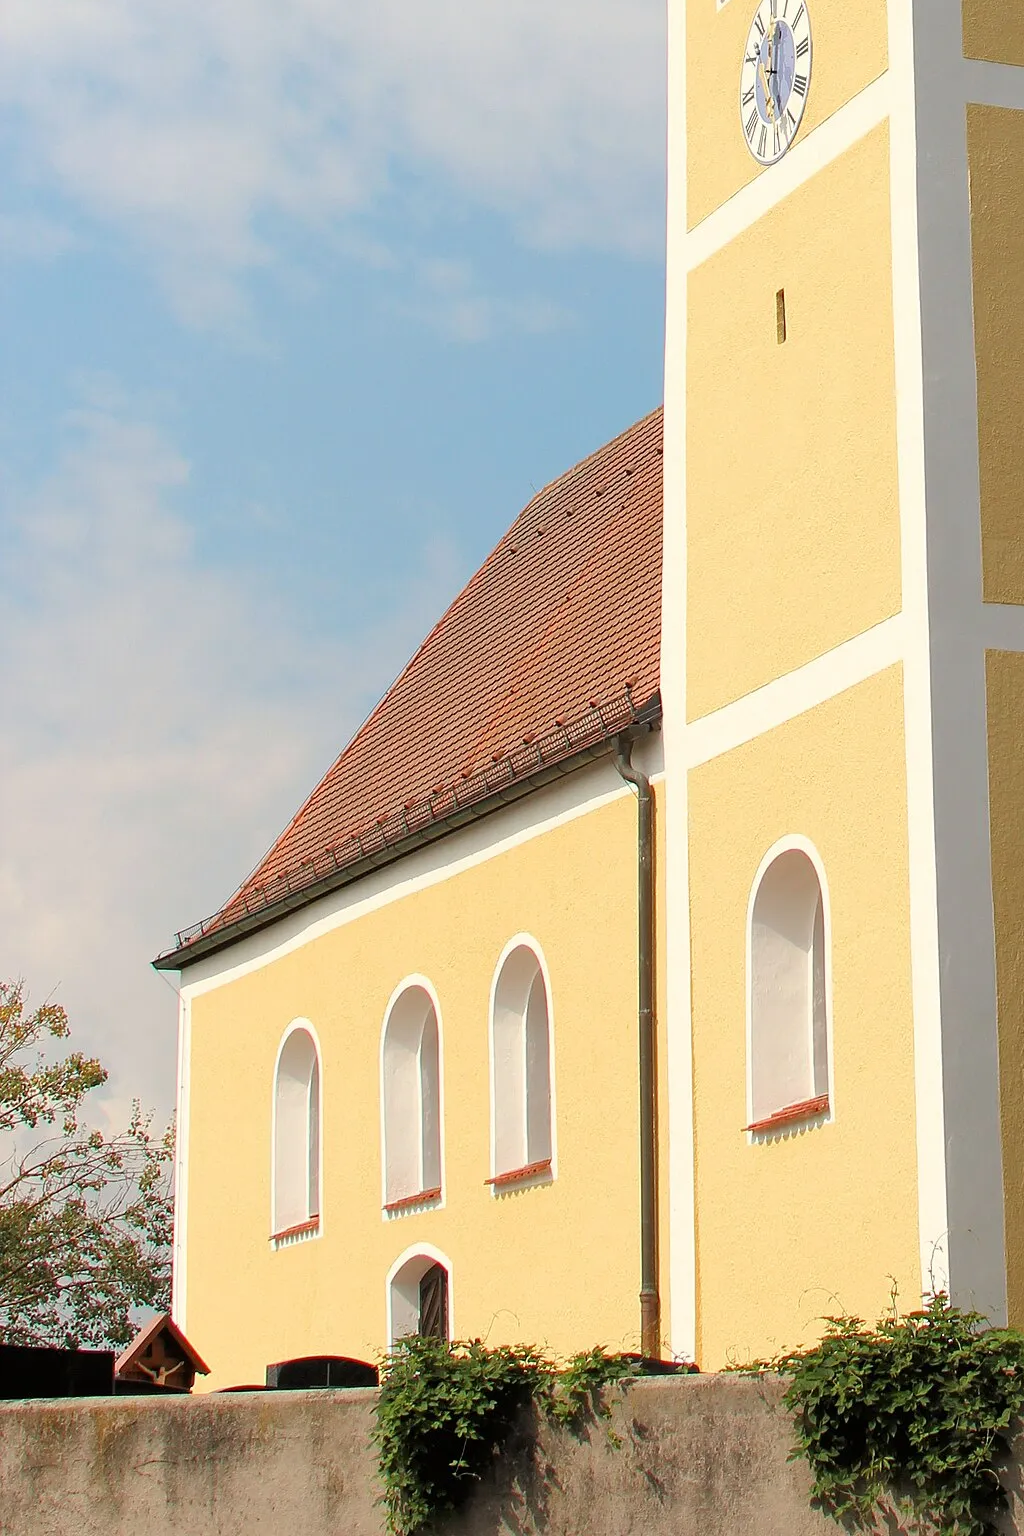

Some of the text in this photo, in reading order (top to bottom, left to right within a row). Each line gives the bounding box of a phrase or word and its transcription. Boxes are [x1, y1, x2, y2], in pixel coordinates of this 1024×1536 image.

[791, 2, 804, 31] II
[796, 34, 808, 58] III
[746, 52, 756, 66] X
